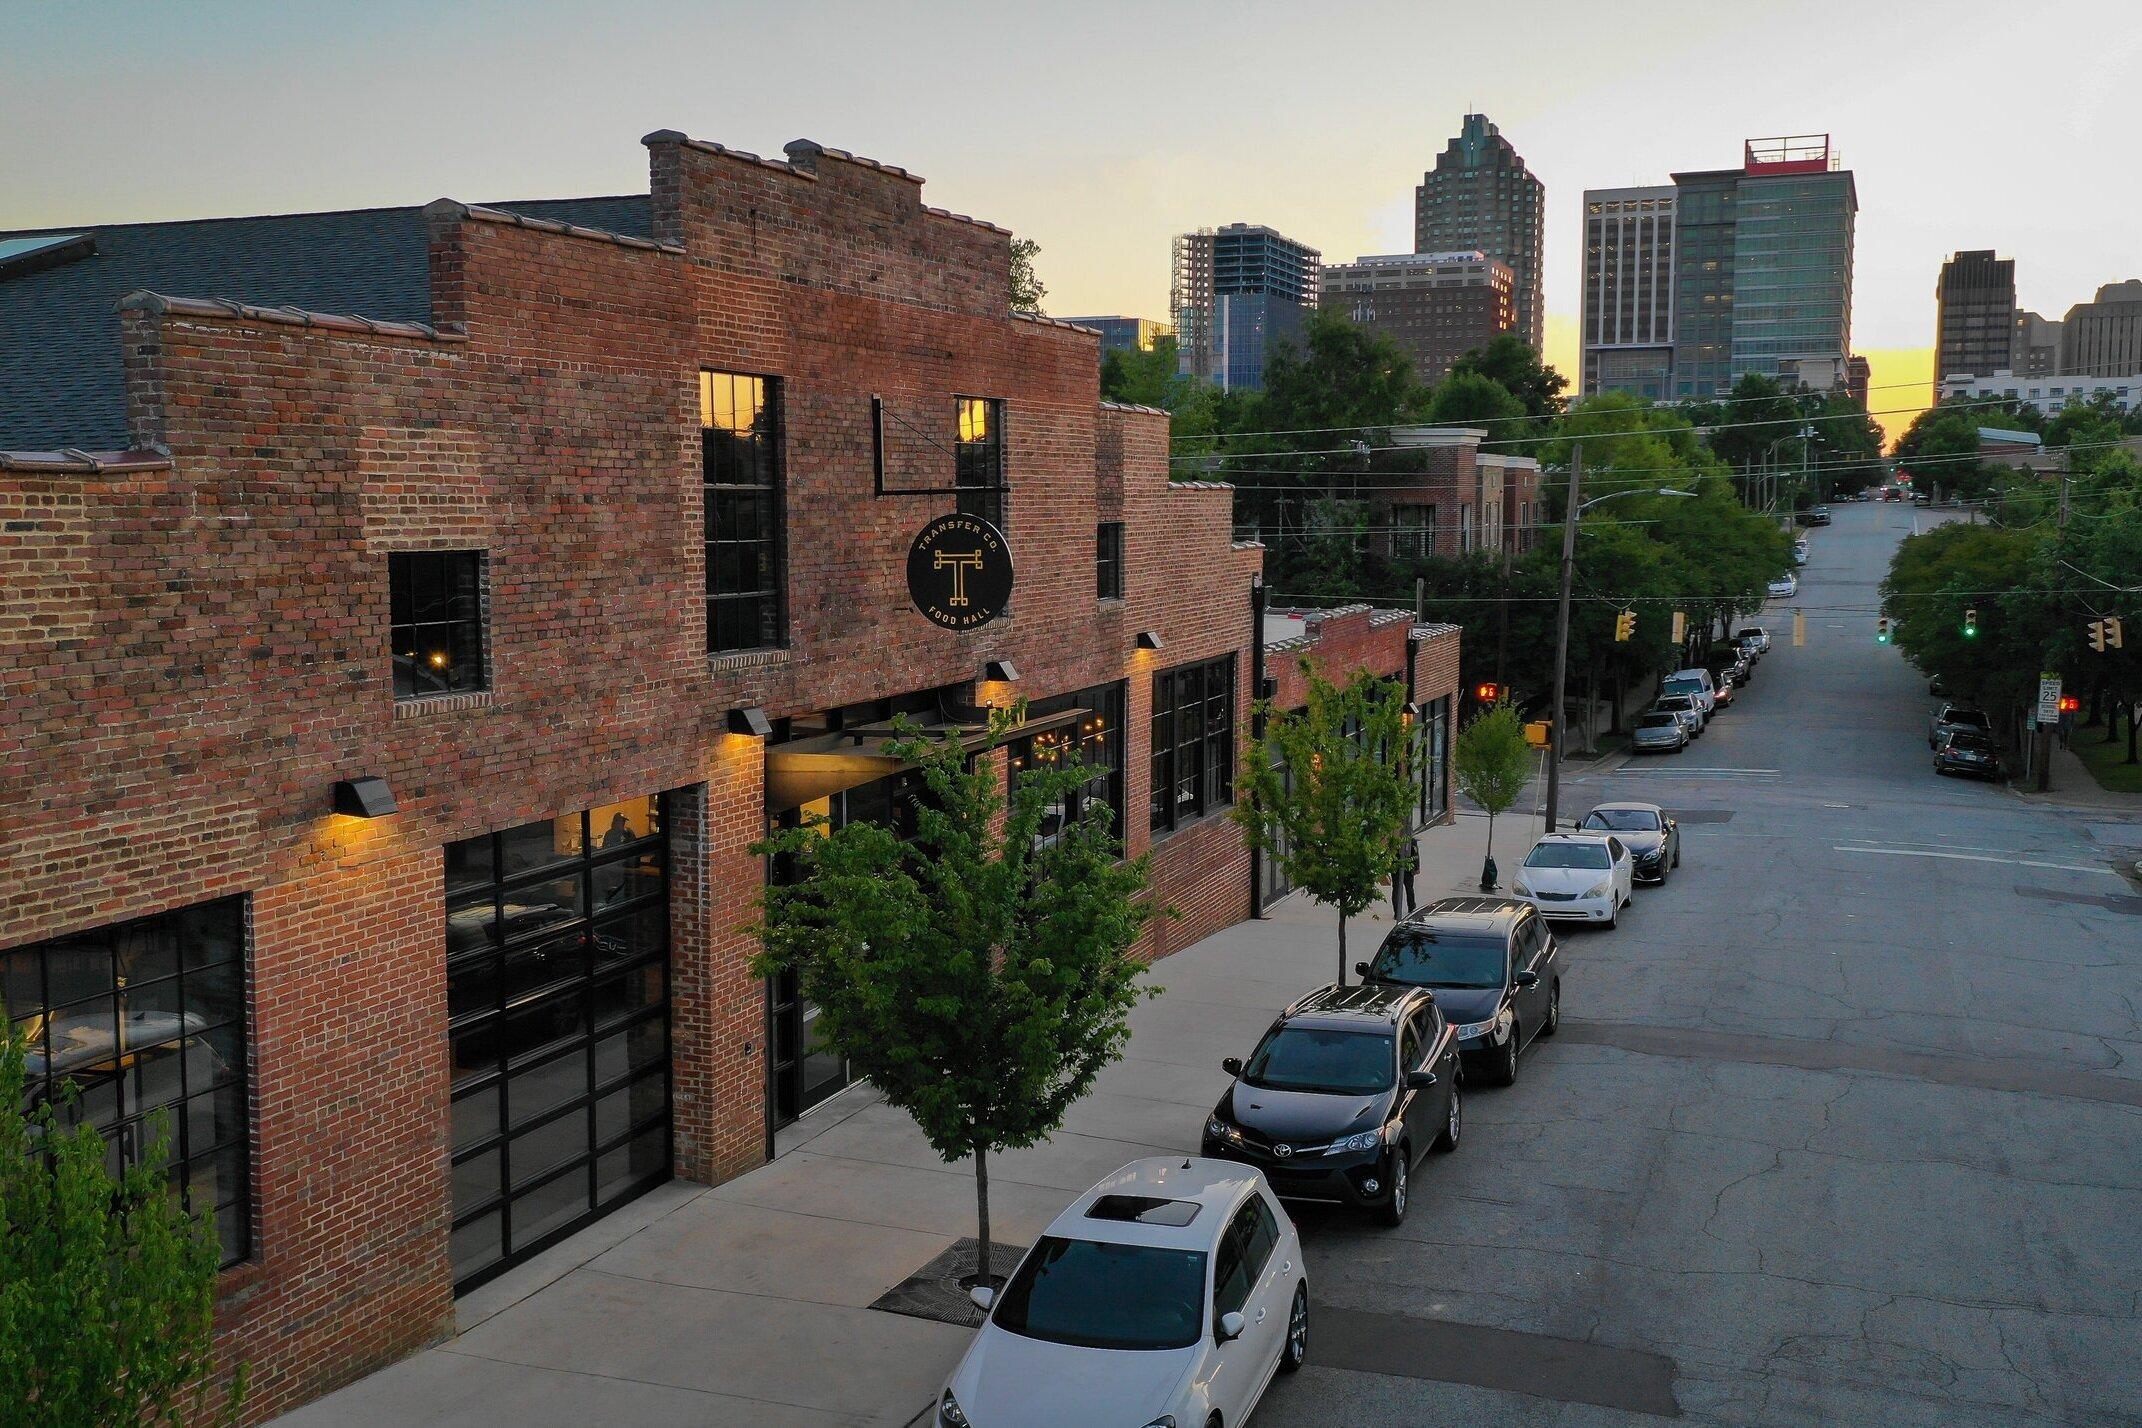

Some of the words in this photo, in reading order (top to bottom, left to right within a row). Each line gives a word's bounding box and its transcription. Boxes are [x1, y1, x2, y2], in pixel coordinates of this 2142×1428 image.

[919, 521, 980, 550] TRANSFER
[983, 533, 998, 552] CO.
[934, 550, 983, 606] T
[928, 606, 957, 625] FOOD
[963, 608, 990, 625] HALL
[2043, 691, 2057, 701] 25
